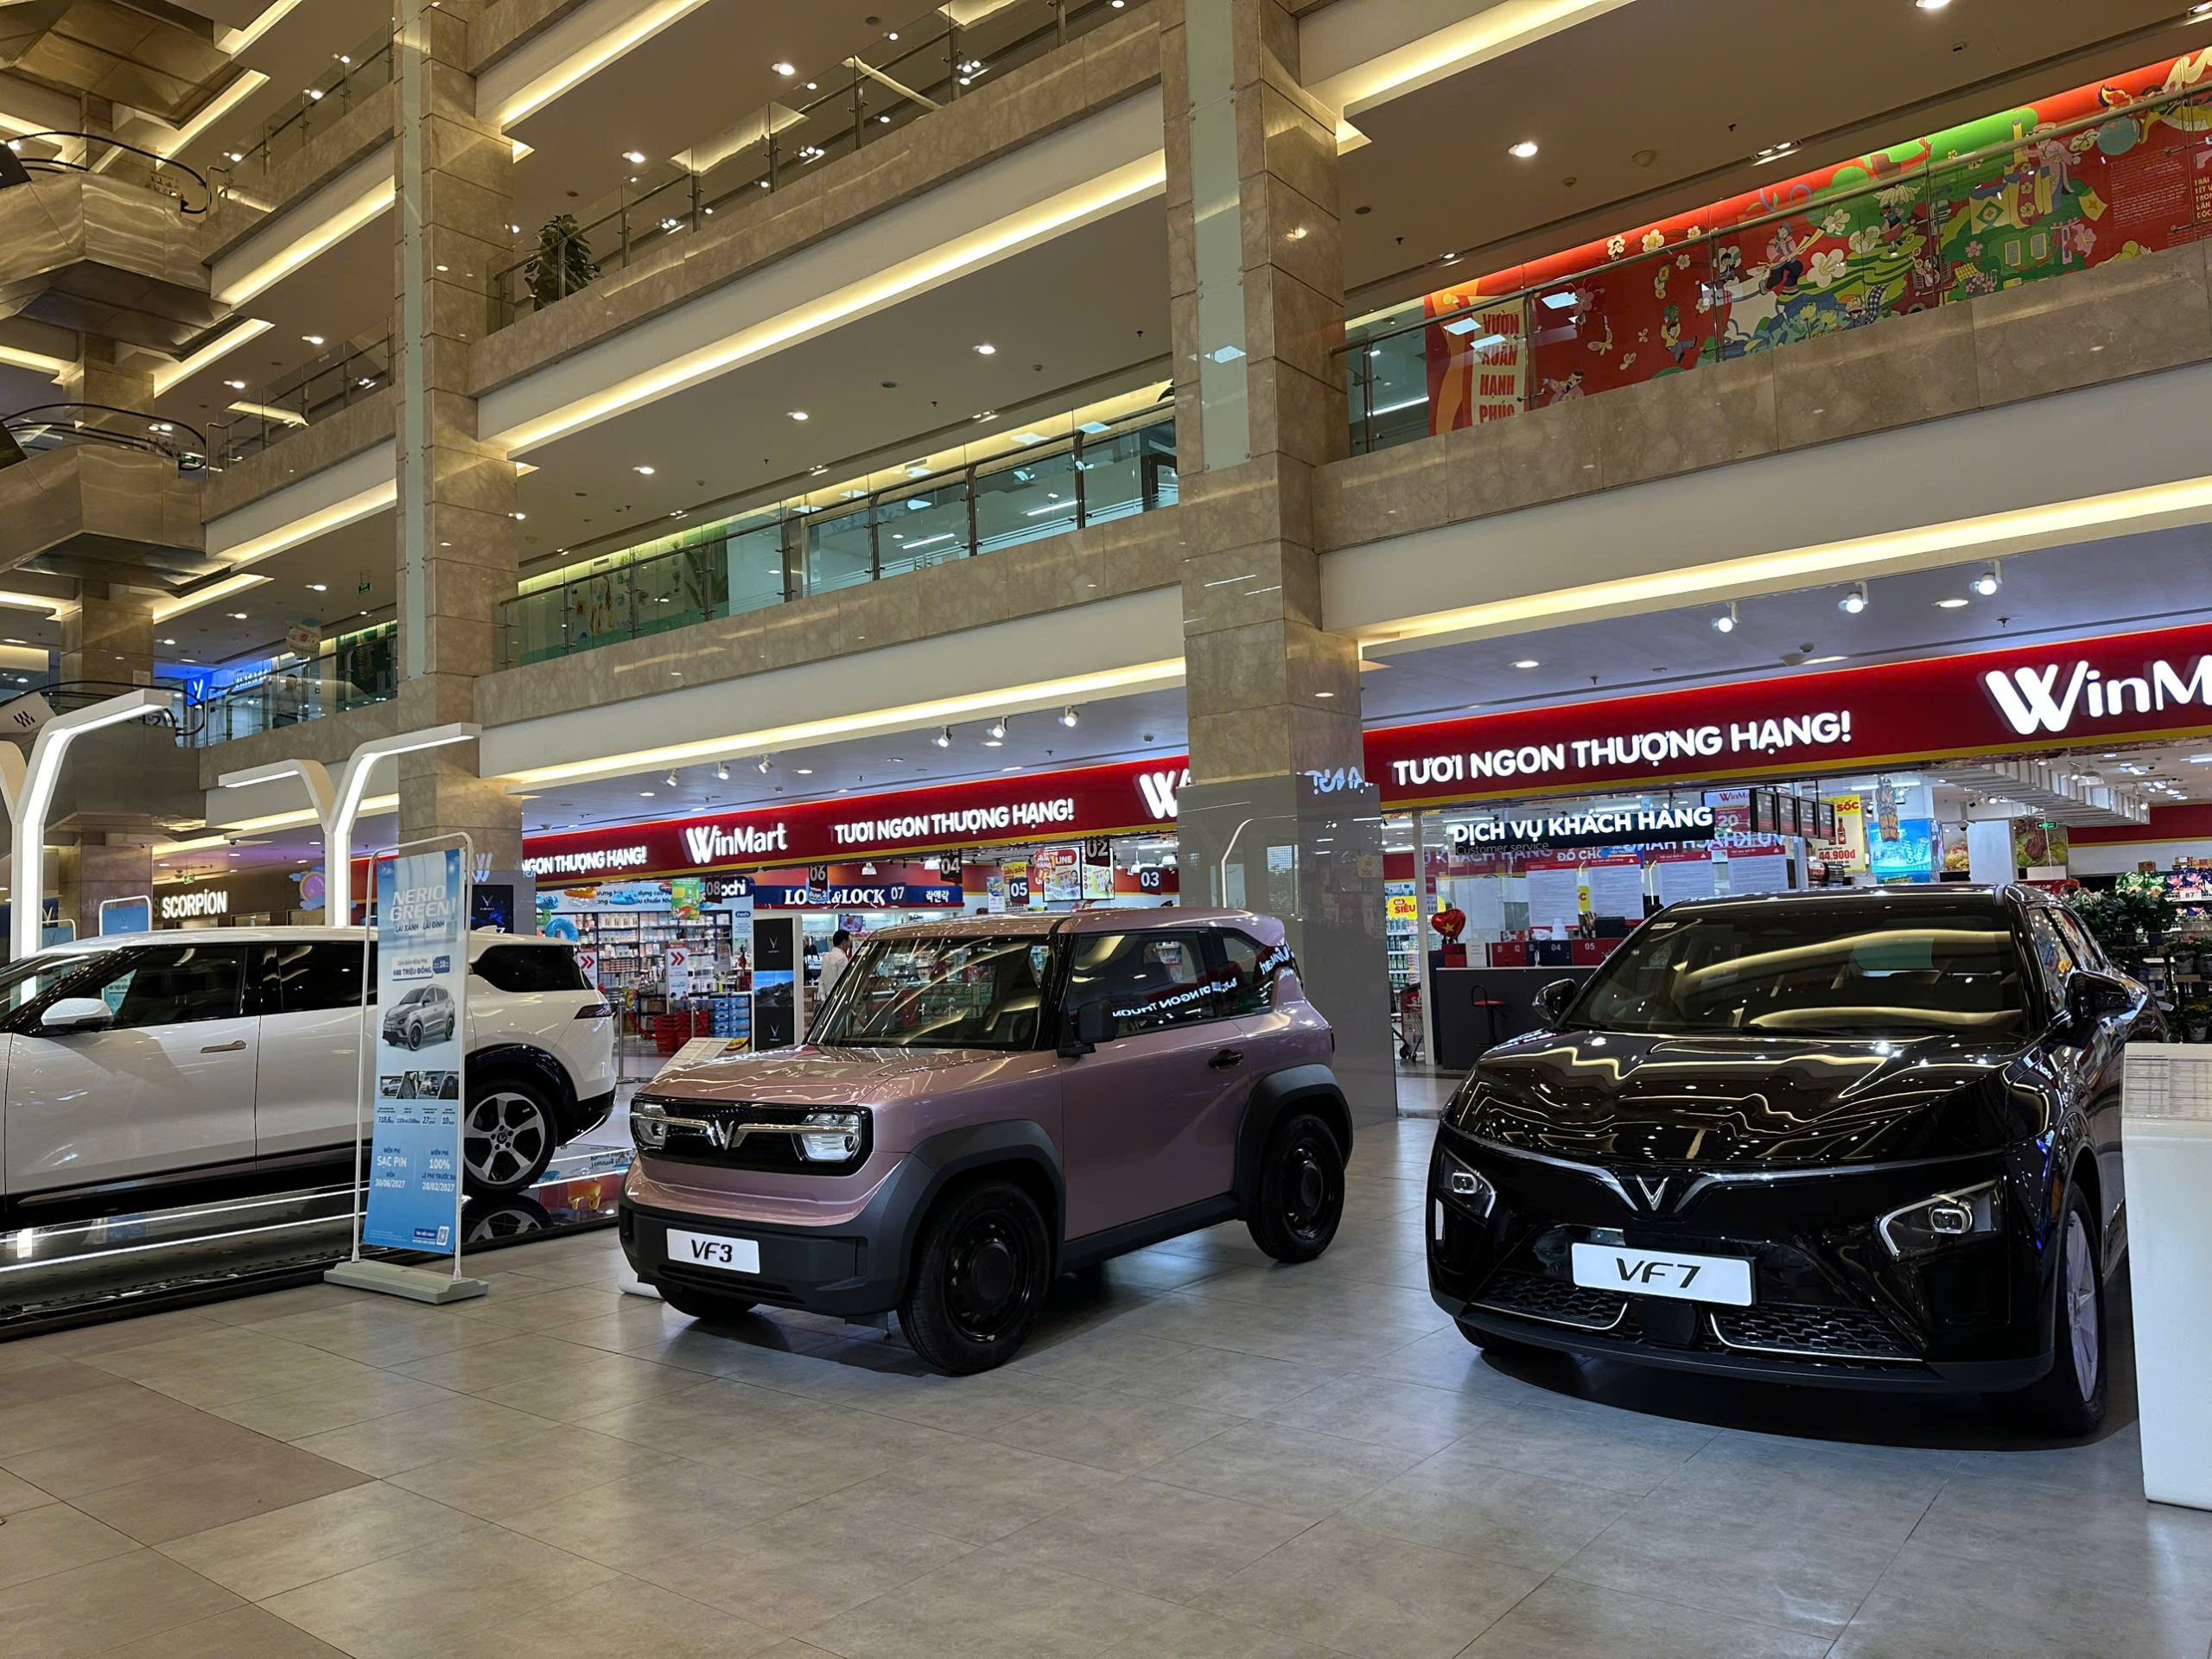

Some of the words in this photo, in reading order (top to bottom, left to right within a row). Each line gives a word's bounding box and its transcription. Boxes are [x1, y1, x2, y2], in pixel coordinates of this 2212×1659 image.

[1482, 309, 1519, 334] VƯỜN
[1479, 374, 1515, 398] HẠNH
[1393, 755, 1464, 787] TƯƠI
[1470, 743, 1566, 779] NGON
[1570, 725, 1724, 766] THƯỢNG
[1729, 709, 1852, 755] HẠNG!
[1835, 799, 1859, 812] SỐC
[834, 820, 874, 844] TƯƠI
[877, 816, 929, 841] NGON
[931, 806, 1009, 835] THƯỢNG
[1012, 798, 1075, 830] HẠNG!
[1452, 822, 1505, 846] DỊCH
[1510, 819, 1543, 842] VỤ
[1548, 809, 1632, 836] KHÁCH
[1637, 803, 1713, 830] HÀNG
[685, 823, 789, 865] WinMart
[1086, 838, 1109, 857] 02
[1456, 845, 1507, 856] Customer
[1511, 842, 1549, 853] service
[554, 851, 606, 874] THƯỢNG
[607, 845, 648, 870] HẠNG!
[1056, 855, 1073, 865] LINE
[1819, 849, 1856, 861] 44.900đ
[809, 865, 827, 881] 06
[940, 857, 961, 874] 04
[1140, 871, 1160, 887] 03
[392, 885, 447, 907] NERIO
[705, 880, 721, 896] 08
[891, 887, 904, 900] 07
[925, 890, 950, 903] 락앤락
[1010, 882, 1028, 897] 05
[784, 889, 885, 906] LO&LOCK
[389, 899, 450, 922] GREEN
[1395, 901, 1416, 914] SIÊU
[377, 1155, 392, 1168] SẠC
[393, 1157, 407, 1167] PIN
[429, 1158, 451, 1170] 100%
[690, 1239, 733, 1263] VF3
[1615, 1257, 1701, 1289] VF7
